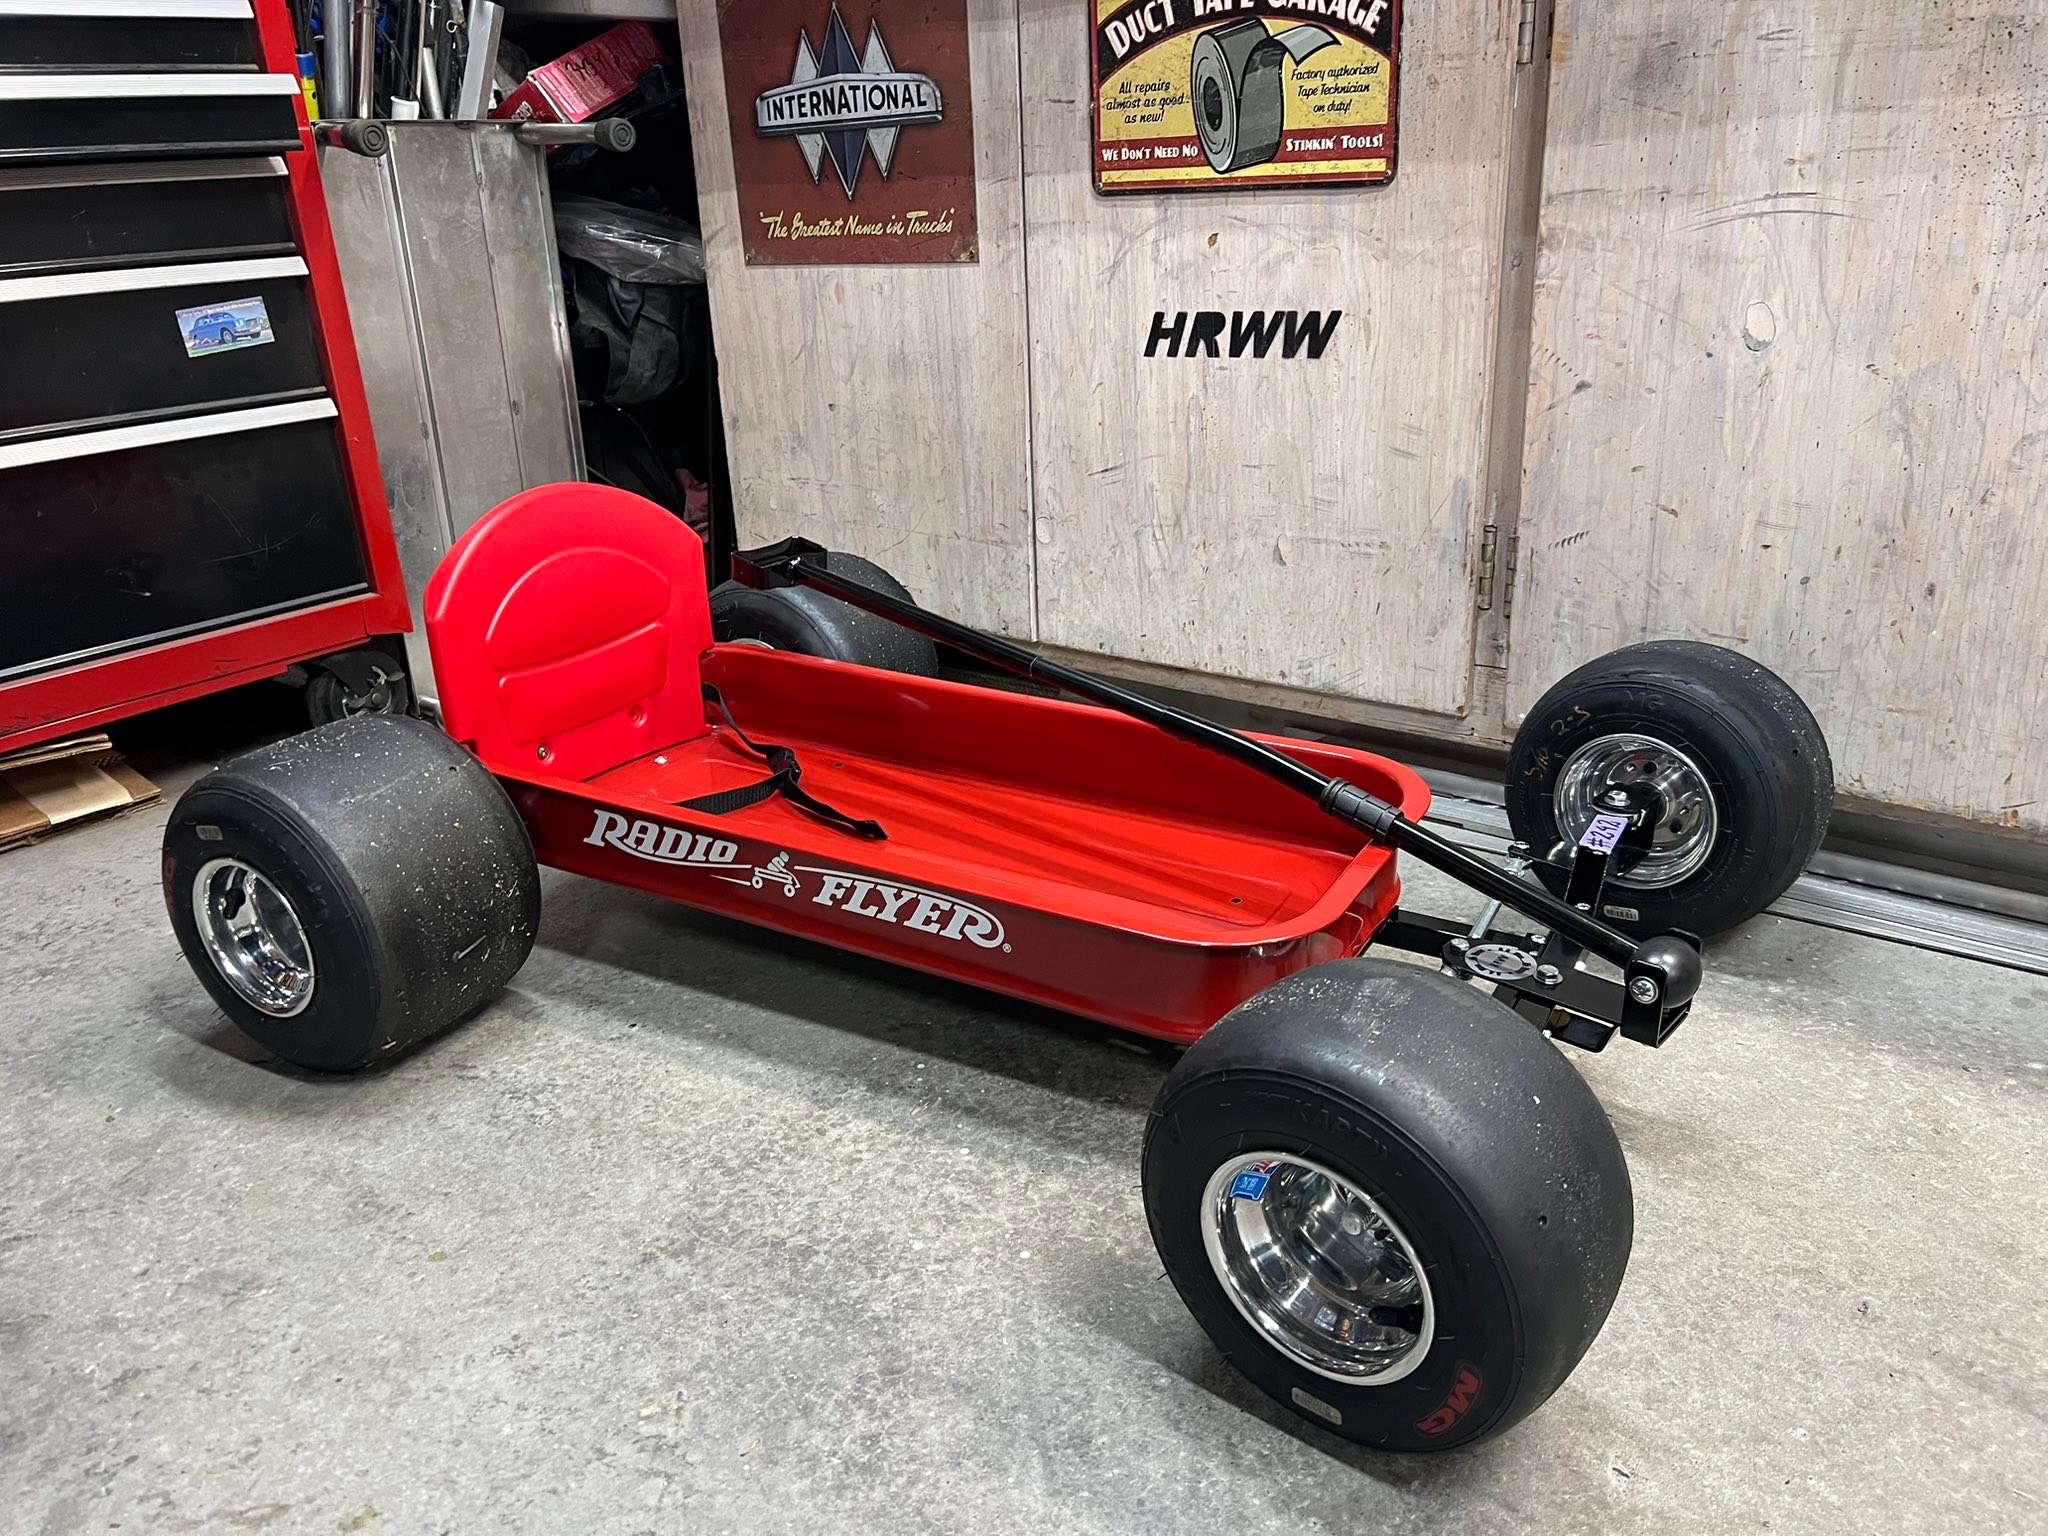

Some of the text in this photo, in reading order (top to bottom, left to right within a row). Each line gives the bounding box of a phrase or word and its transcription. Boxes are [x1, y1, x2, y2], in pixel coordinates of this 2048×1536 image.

[1104, 0, 1175, 59] DUCT
[1291, 62, 1379, 81] Factory authorized
[1118, 79, 1171, 96] All repairs
[1297, 81, 1370, 99] Tape Technician
[767, 84, 928, 121] INTERNATIONAL
[1106, 97, 1141, 110] almost
[1143, 98, 1156, 108] as
[1124, 109, 1165, 123] as new!
[1313, 98, 1353, 114] on duty!
[1101, 148, 1119, 161] WE
[1154, 145, 1180, 159] NEED
[1182, 144, 1198, 157] NO
[1340, 133, 1384, 149] TOOLS!
[790, 211, 845, 240] Greatest
[844, 215, 883, 236] Name
[886, 214, 904, 235] in
[1143, 310, 1343, 360] HRWW
[583, 808, 740, 864] RADIO
[1416, 1368, 1480, 1435] MG
